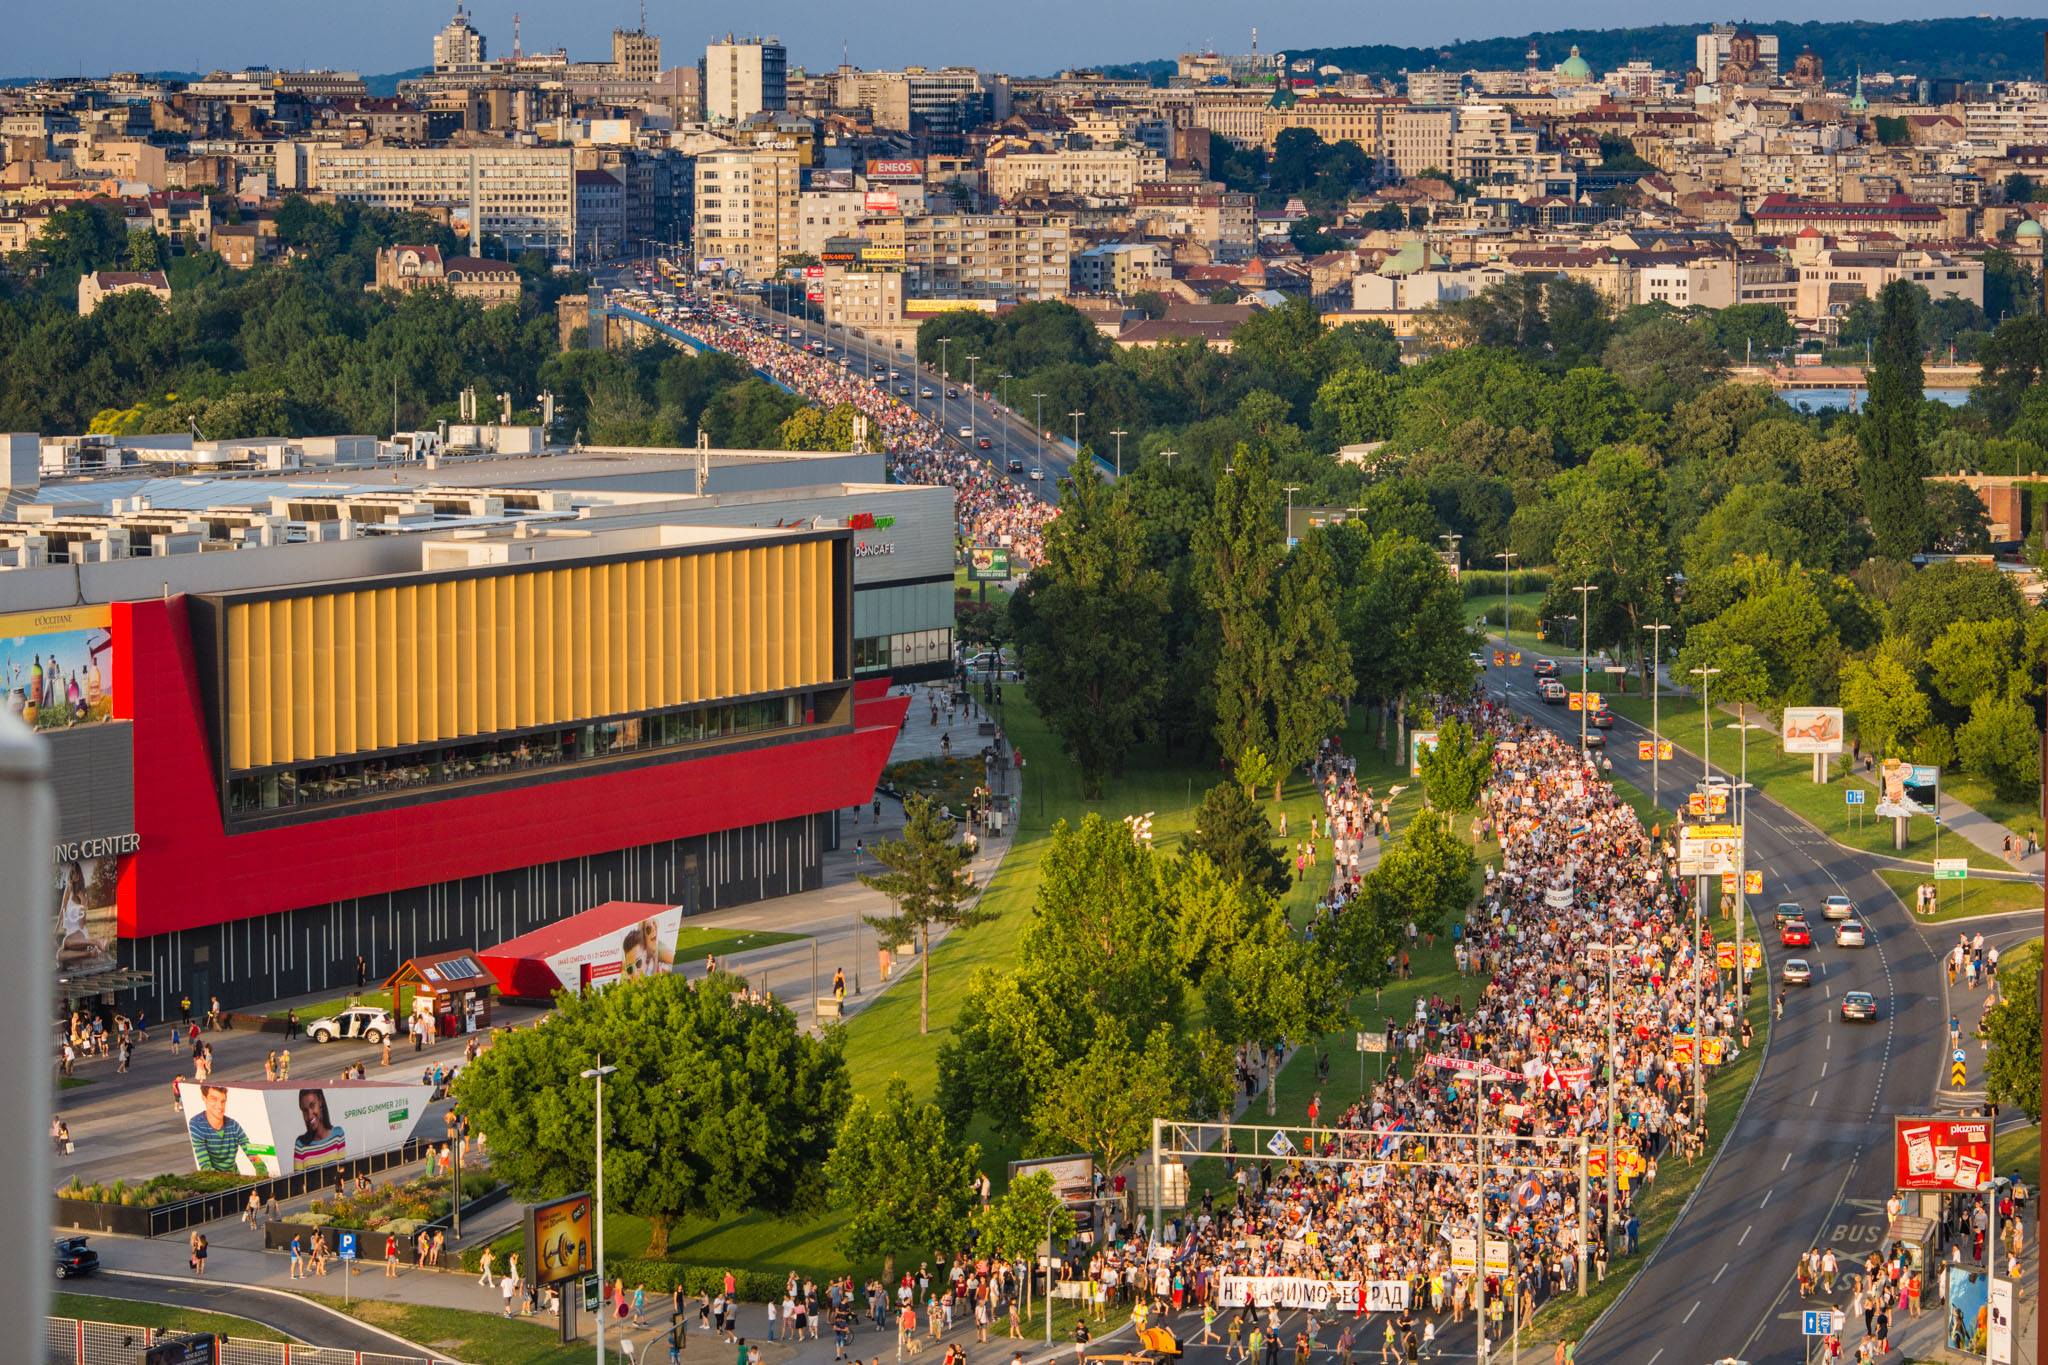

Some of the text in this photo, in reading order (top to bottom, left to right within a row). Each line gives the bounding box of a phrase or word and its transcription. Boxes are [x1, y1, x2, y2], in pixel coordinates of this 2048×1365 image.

[756, 138, 795, 149] Ceresit
[878, 162, 912, 172] ENEOS
[855, 542, 895, 557] DONCAFE
[34, 615, 72, 626] L'OCCITANE
[82, 833, 141, 859] CENTER
[1428, 1055, 1447, 1066] FREE
[1451, 1060, 1468, 1069] THE
[344, 1098, 409, 1119] SPRING SUMMER 2016
[1950, 1124, 1985, 1135] plazma
[1829, 1224, 1881, 1242] BUS
[343, 1235, 353, 1247] P
